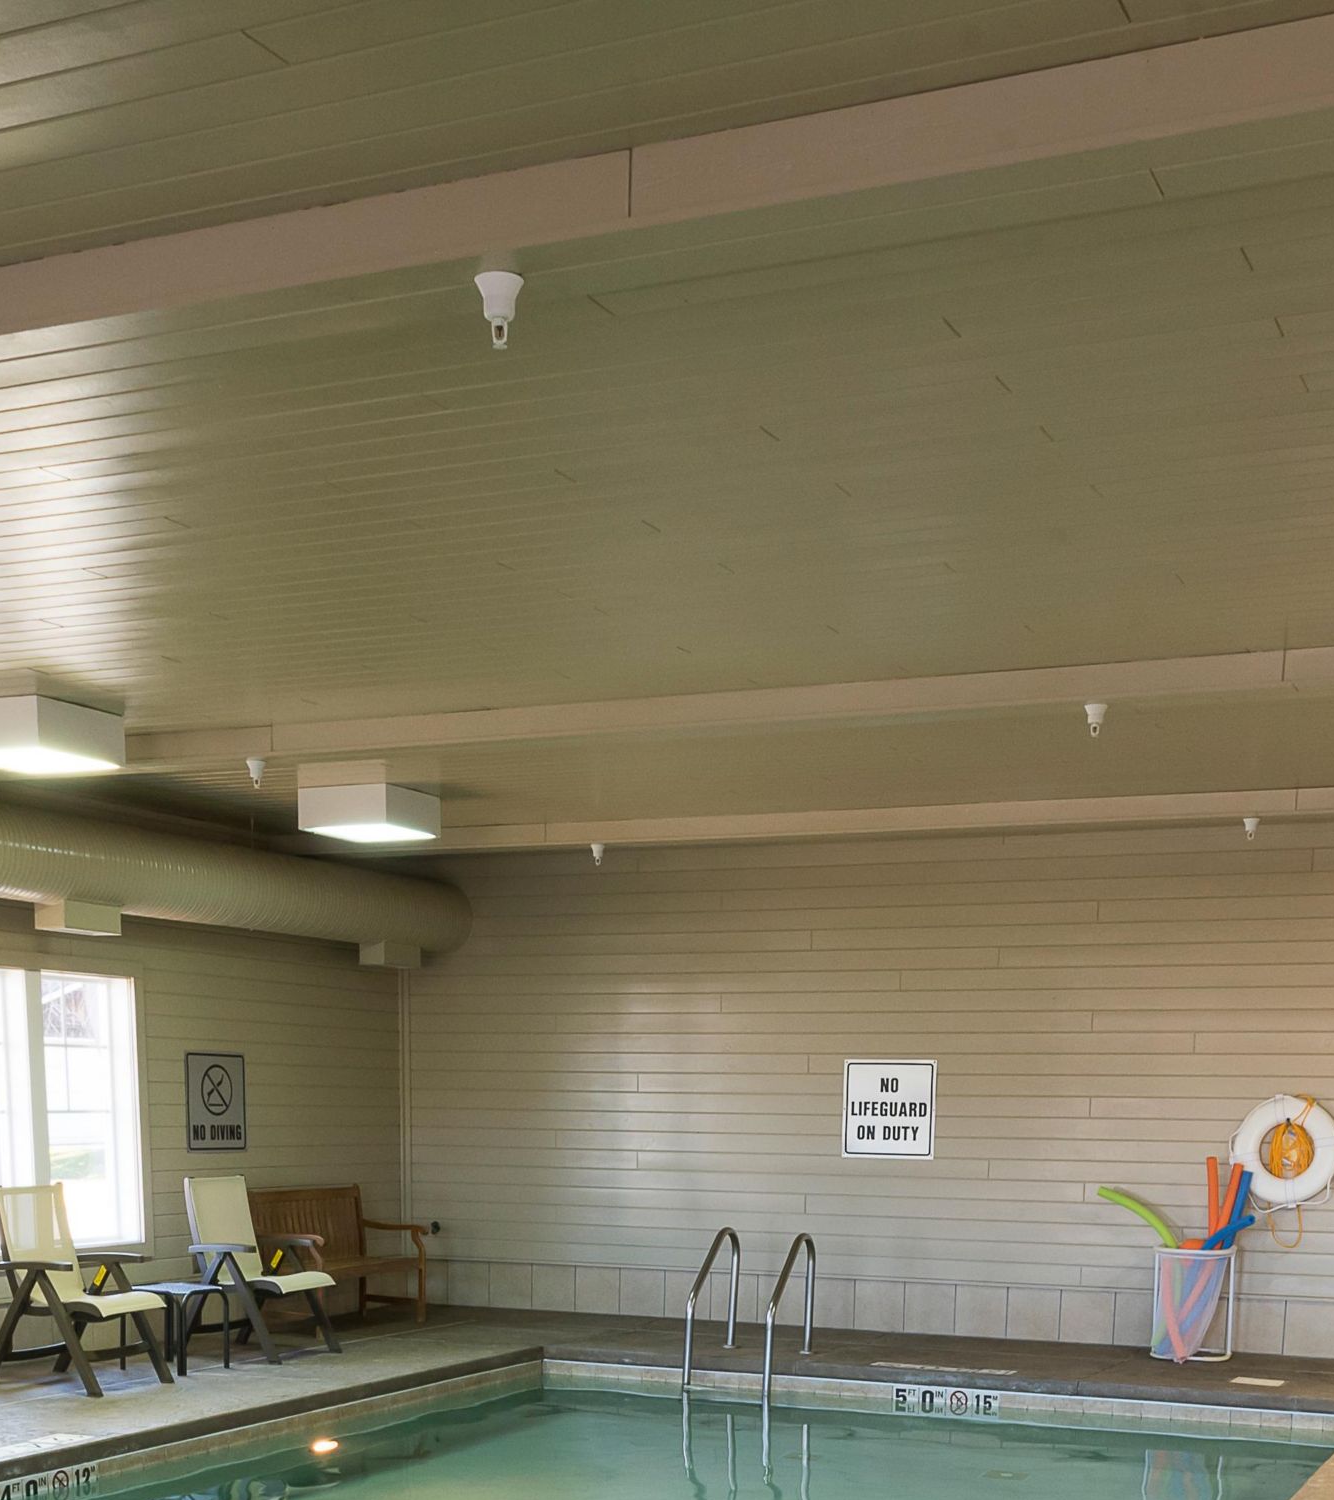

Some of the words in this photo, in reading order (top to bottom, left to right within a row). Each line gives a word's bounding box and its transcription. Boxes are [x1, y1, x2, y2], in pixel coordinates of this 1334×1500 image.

[880, 1078, 899, 1093] NO
[851, 1101, 928, 1118] LIFEGUARD
[193, 1124, 206, 1140] NO
[210, 1124, 242, 1141] DIVING
[857, 1125, 876, 1141] ON
[883, 1125, 919, 1142] DUTY
